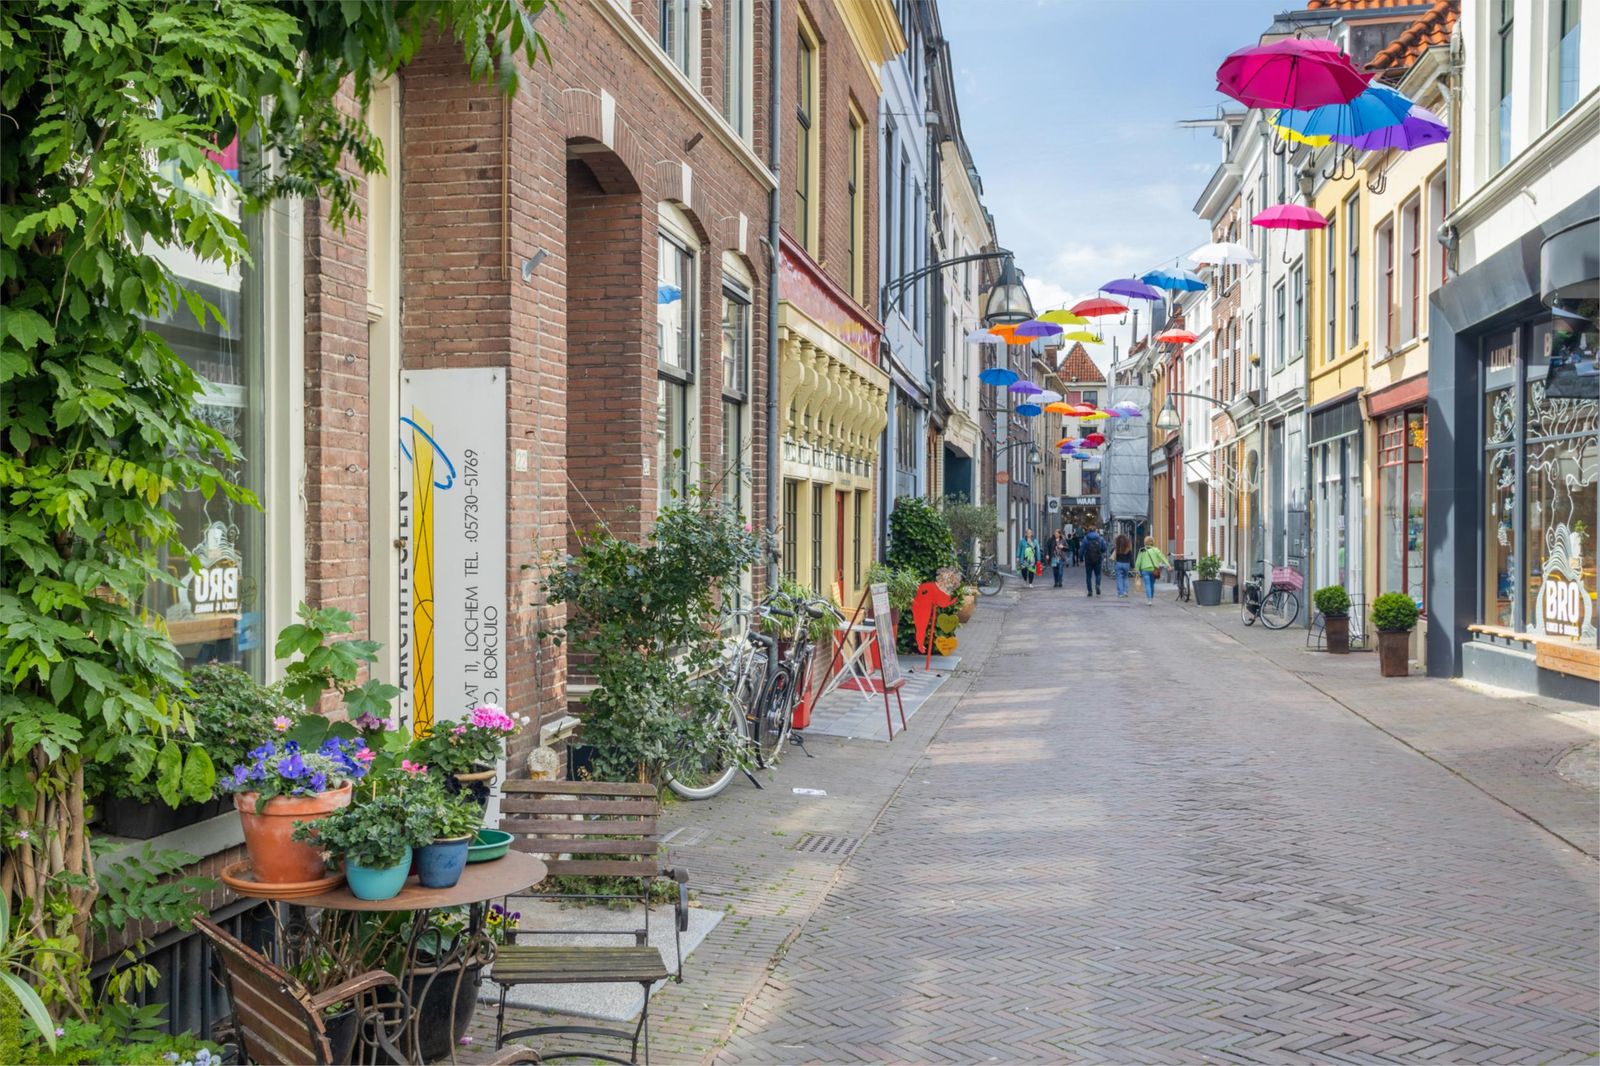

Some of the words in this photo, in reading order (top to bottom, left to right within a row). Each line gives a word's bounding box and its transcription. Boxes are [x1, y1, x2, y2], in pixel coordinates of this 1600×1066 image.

[1076, 497, 1096, 505] WAAR
[465, 552, 479, 577] TEL.
[465, 586, 479, 652] LOCHEM
[1546, 581, 1580, 623] BRO
[484, 606, 498, 679] BORCULO
